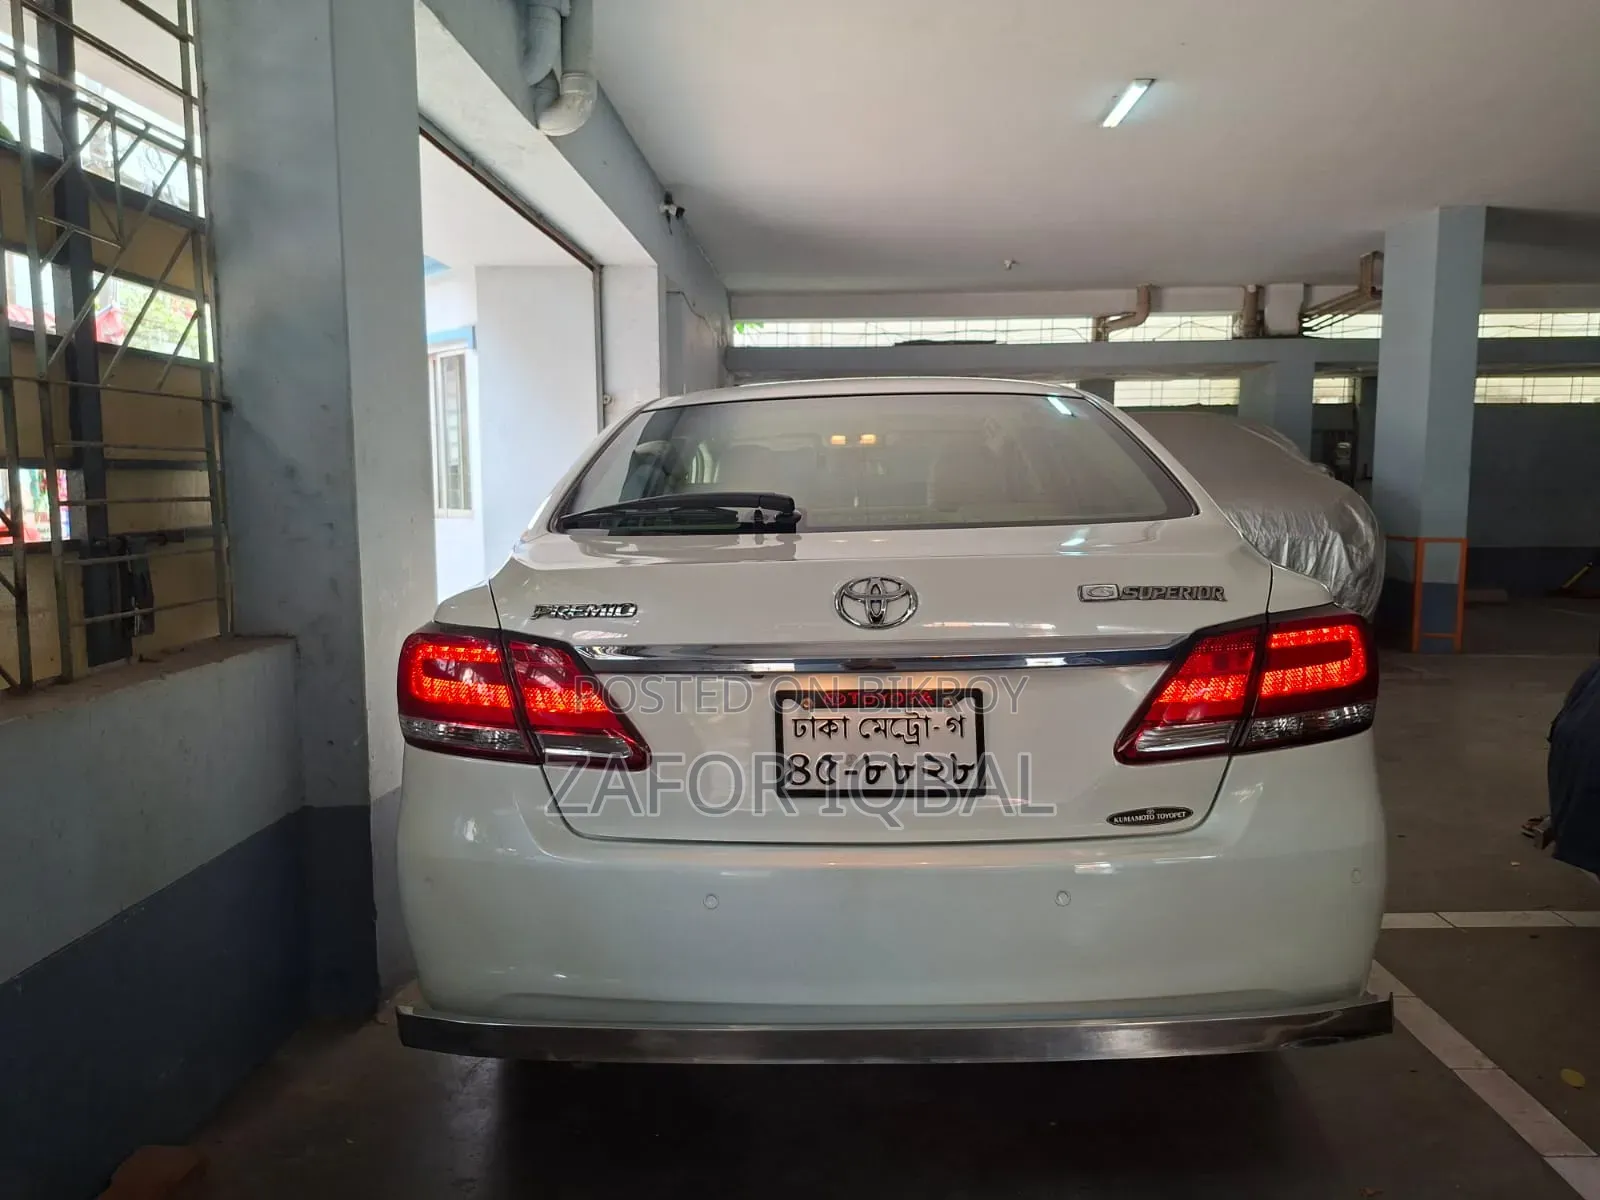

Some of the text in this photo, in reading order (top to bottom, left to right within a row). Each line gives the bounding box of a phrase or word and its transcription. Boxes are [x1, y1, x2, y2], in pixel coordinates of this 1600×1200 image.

[1121, 585, 1227, 601] SUPERIOR
[530, 602, 638, 620] PREMIO
[791, 715, 849, 739] ঢাকা
[787, 752, 975, 786] ৪৫-৮৮২৮
[1113, 811, 1186, 824] KUMAMOTO TOYOPET
